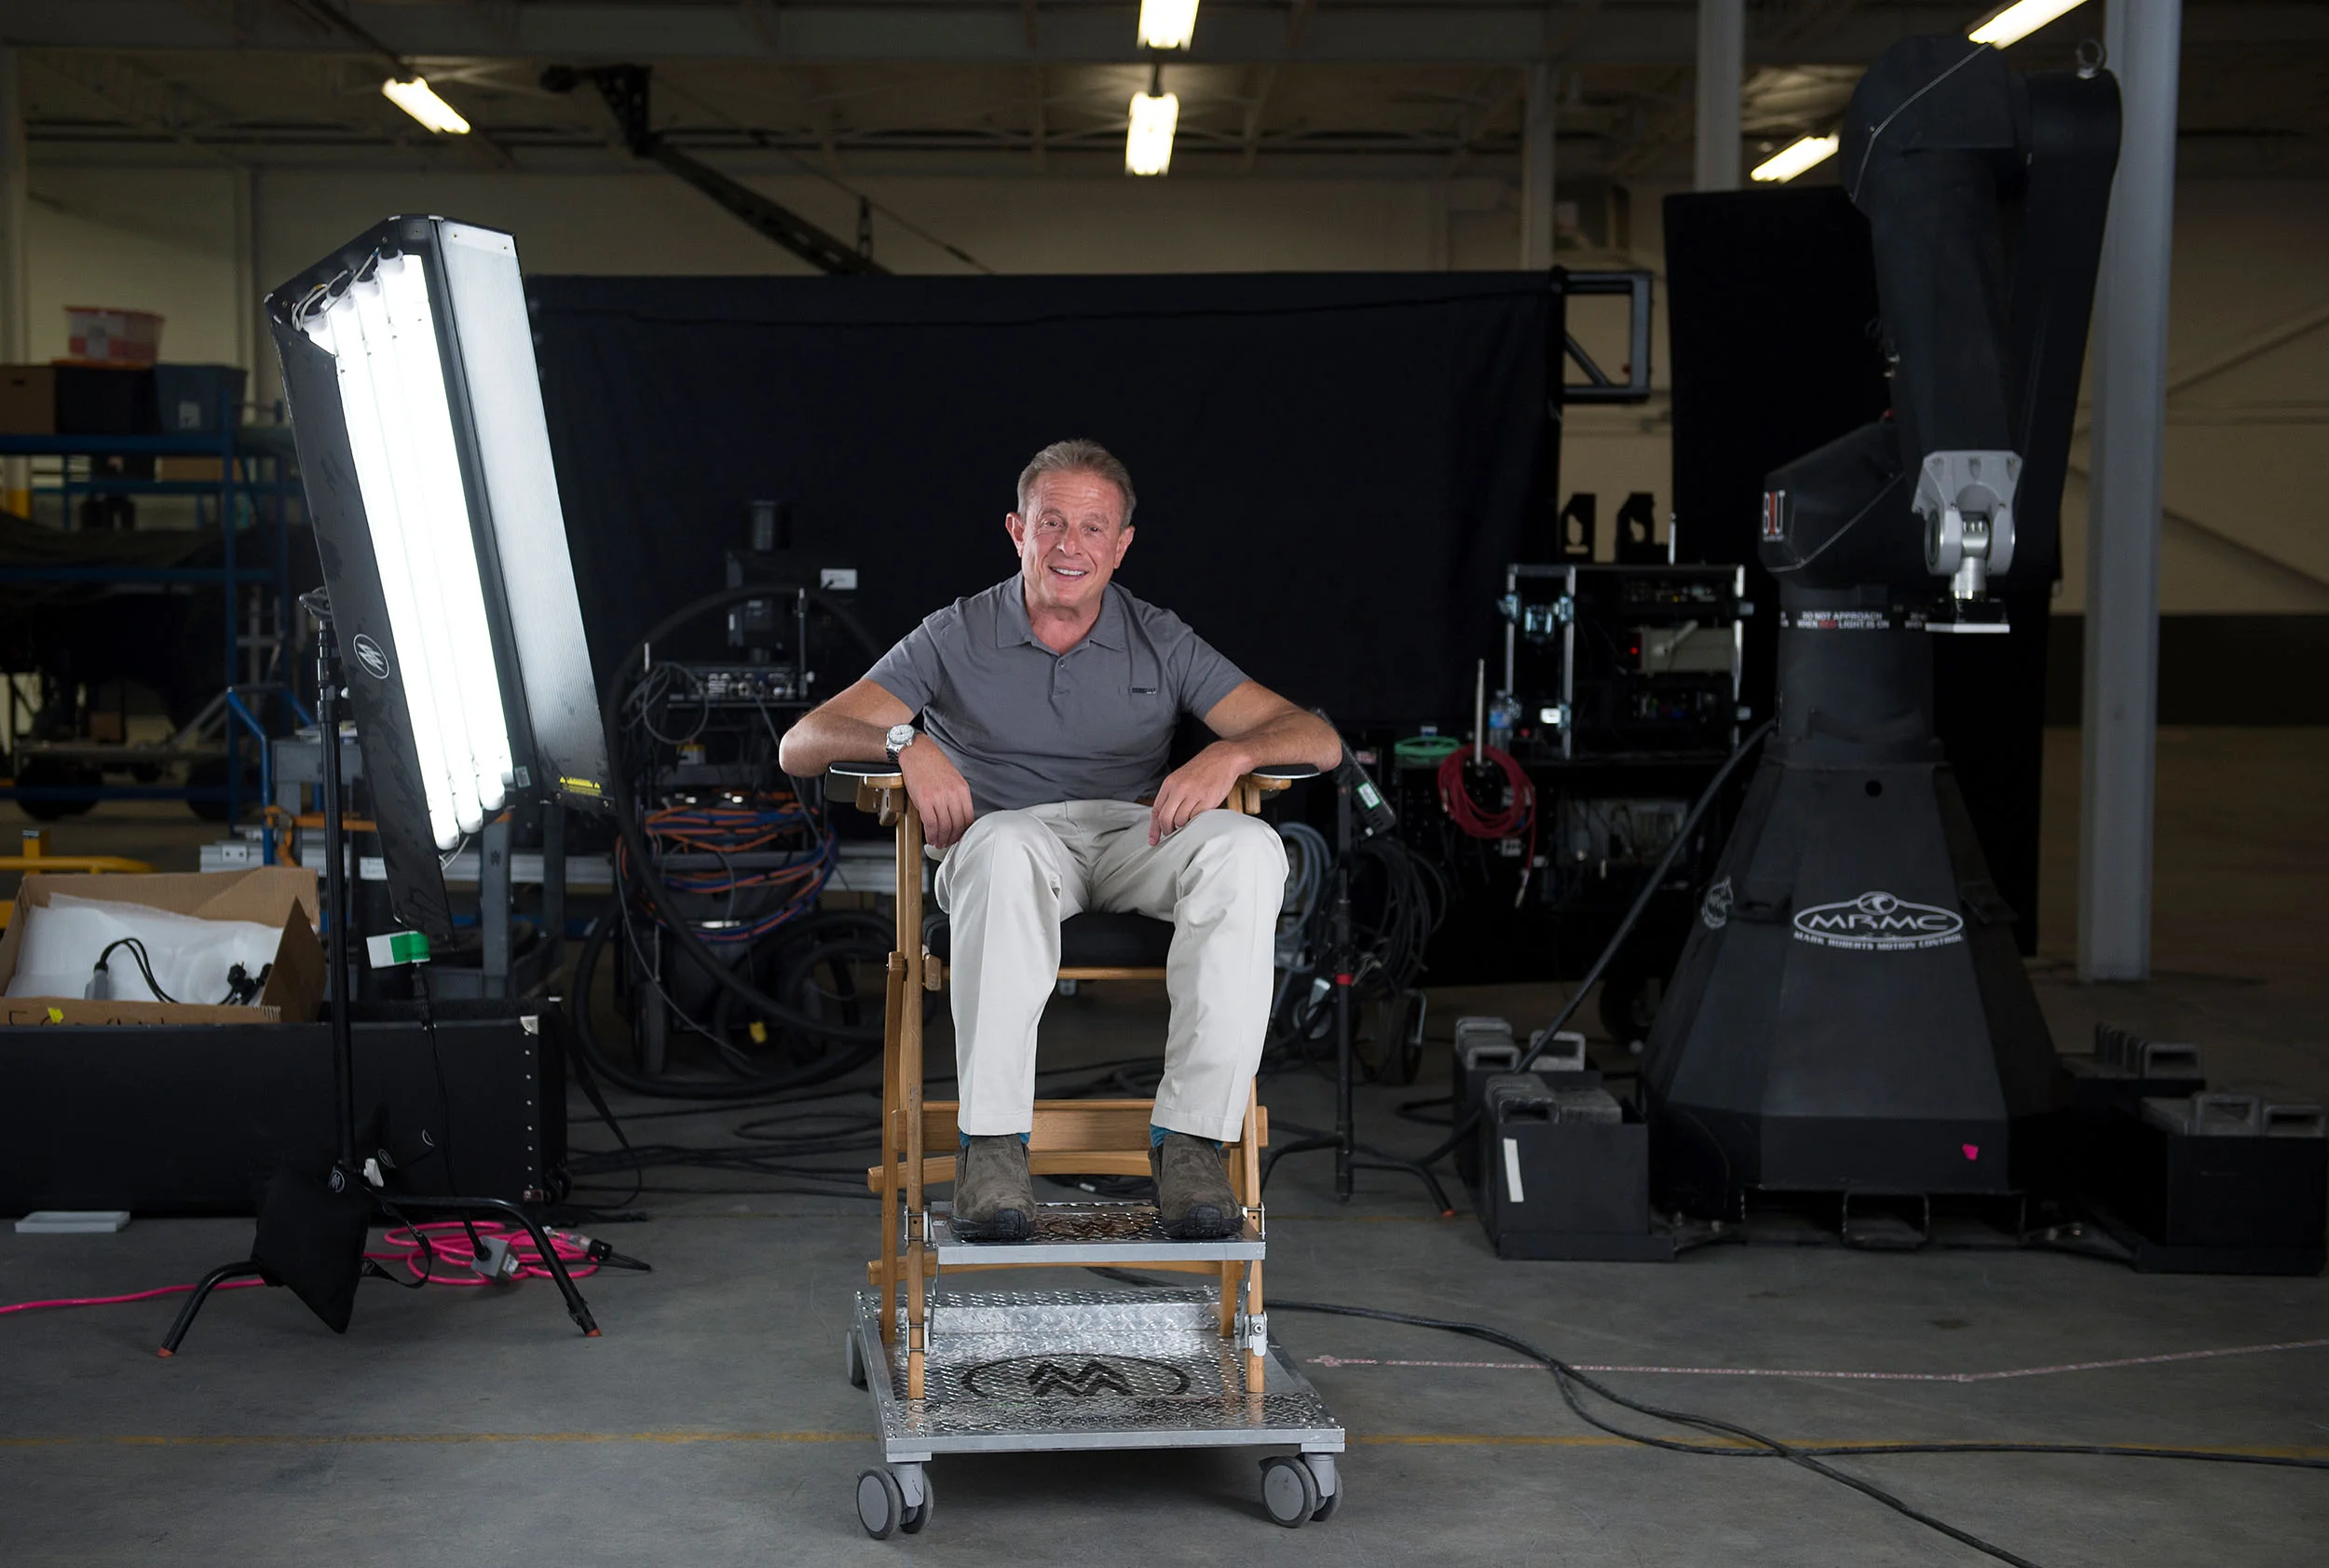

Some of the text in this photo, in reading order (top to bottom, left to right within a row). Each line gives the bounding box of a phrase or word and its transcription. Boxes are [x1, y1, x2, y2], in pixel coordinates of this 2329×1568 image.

[1814, 611, 1832, 620] NOT
[1832, 611, 1883, 620] APPROACH
[1796, 620, 1818, 629] WHEN
[1838, 620, 1865, 629] LIGHT
[1876, 620, 1890, 629] ON
[1808, 914, 1949, 930] MRMC
[1793, 931, 1963, 950] MARK ROBERTS MOTION CONTROL
